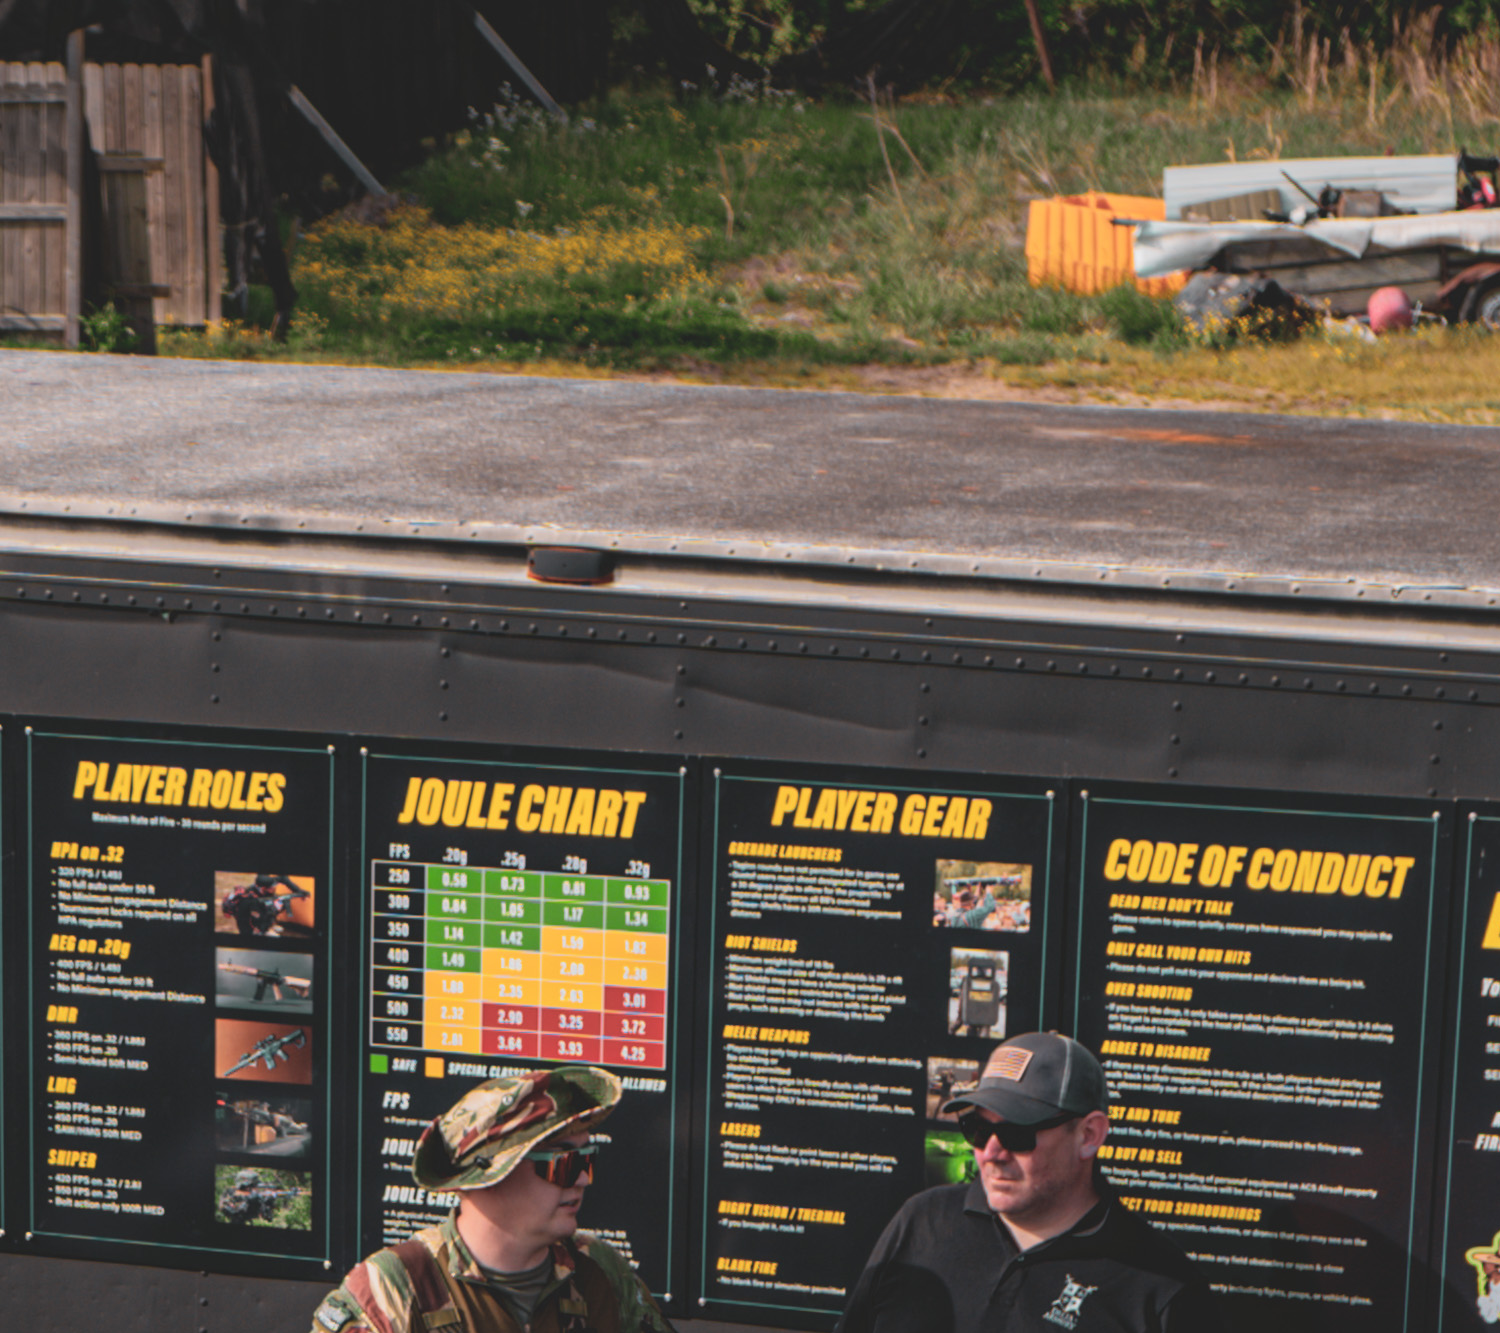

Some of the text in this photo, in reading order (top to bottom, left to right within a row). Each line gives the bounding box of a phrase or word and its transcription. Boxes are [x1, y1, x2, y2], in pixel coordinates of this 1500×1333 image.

[73, 761, 286, 813] PLAYER ROLES
[397, 777, 647, 839] JOULE CHART
[771, 785, 993, 840] PLAYER GEAR
[51, 841, 125, 863] HPA on .32
[389, 843, 410, 859] FPS
[501, 851, 526, 870] .25g
[625, 860, 650, 879] .32g
[1104, 838, 1415, 899] CODE OF CONDUCT
[622, 1019, 646, 1034] 3.72
[721, 1122, 761, 1137] LASERS
